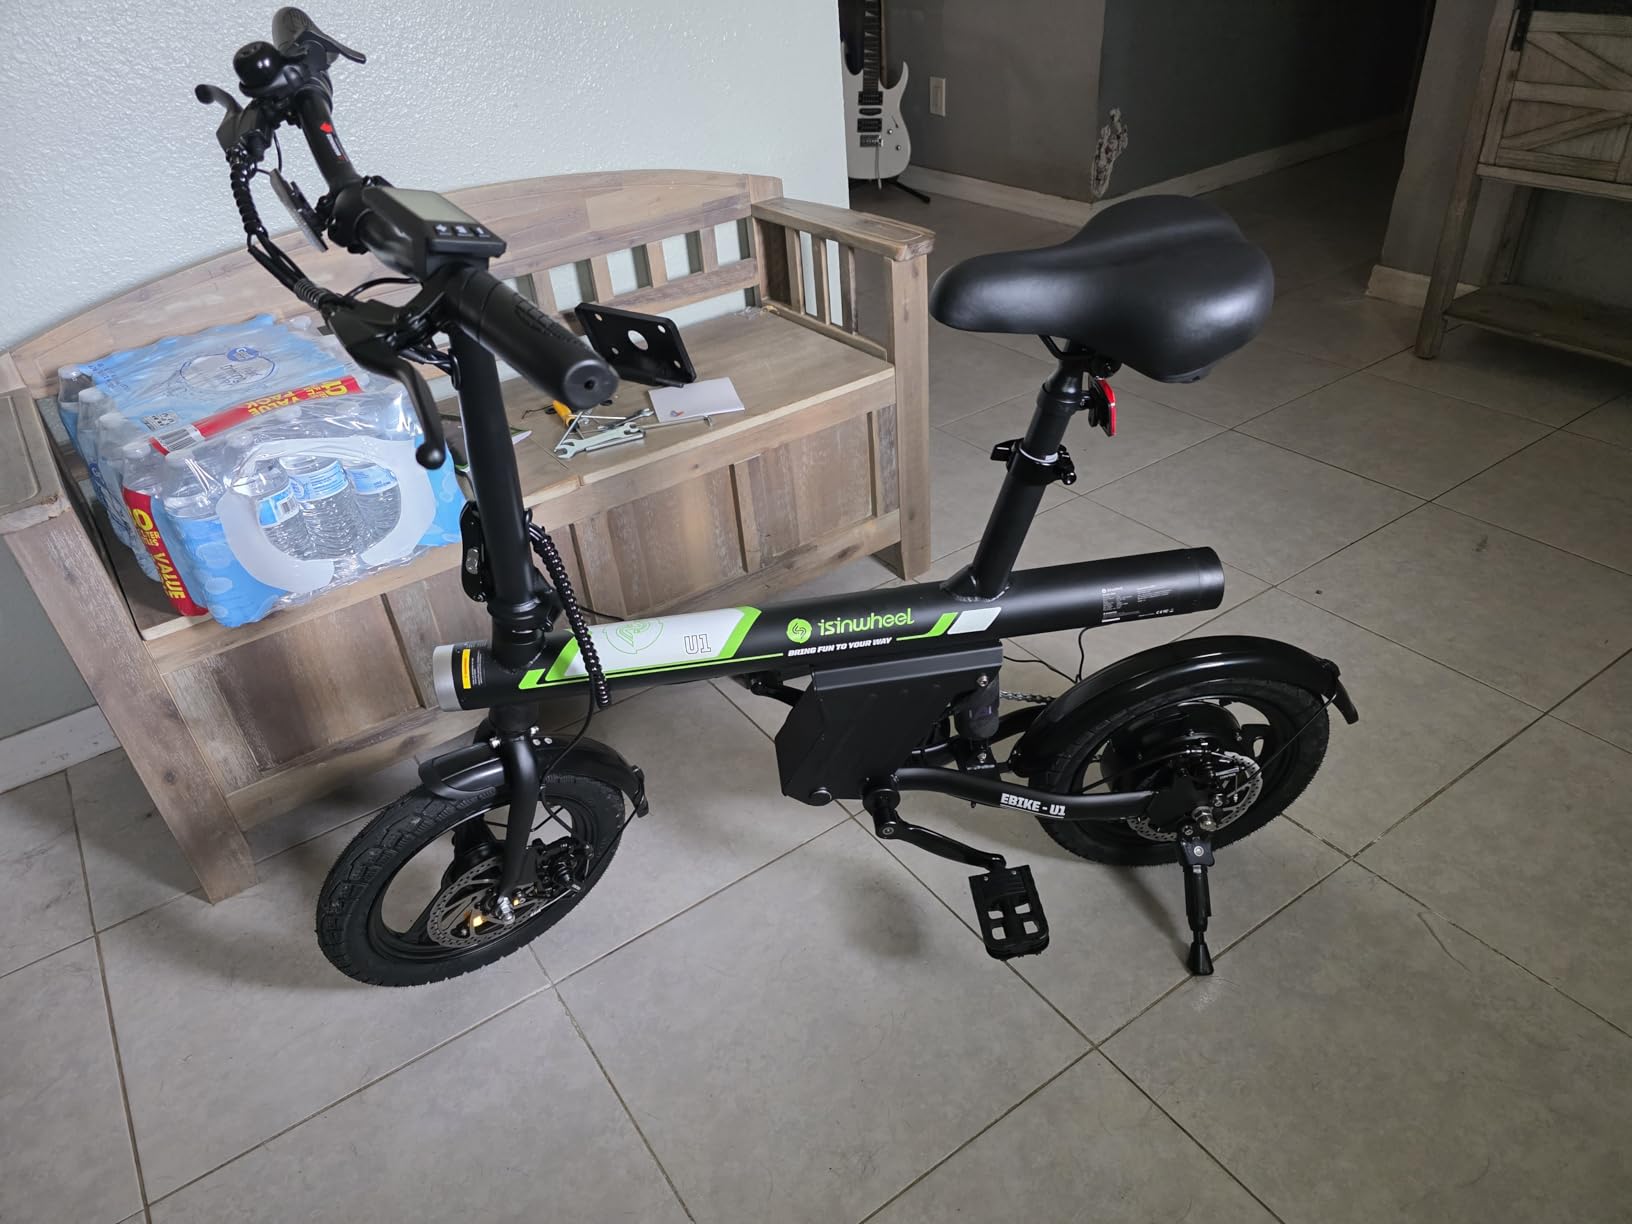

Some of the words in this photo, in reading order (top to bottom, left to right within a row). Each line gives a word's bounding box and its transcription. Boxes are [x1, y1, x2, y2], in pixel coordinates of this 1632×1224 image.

[247, 396, 301, 417] VALUE
[154, 552, 186, 599] VALUE
[818, 607, 915, 636] isinwheel
[684, 633, 712, 655] U1
[788, 646, 817, 657] BRING
[817, 643, 835, 653] FUN
[836, 641, 847, 651] TO
[848, 639, 872, 649] YOUR
[873, 636, 893, 646] WAY
[1001, 792, 1041, 812] EBIKE
[1049, 804, 1066, 816] U1
